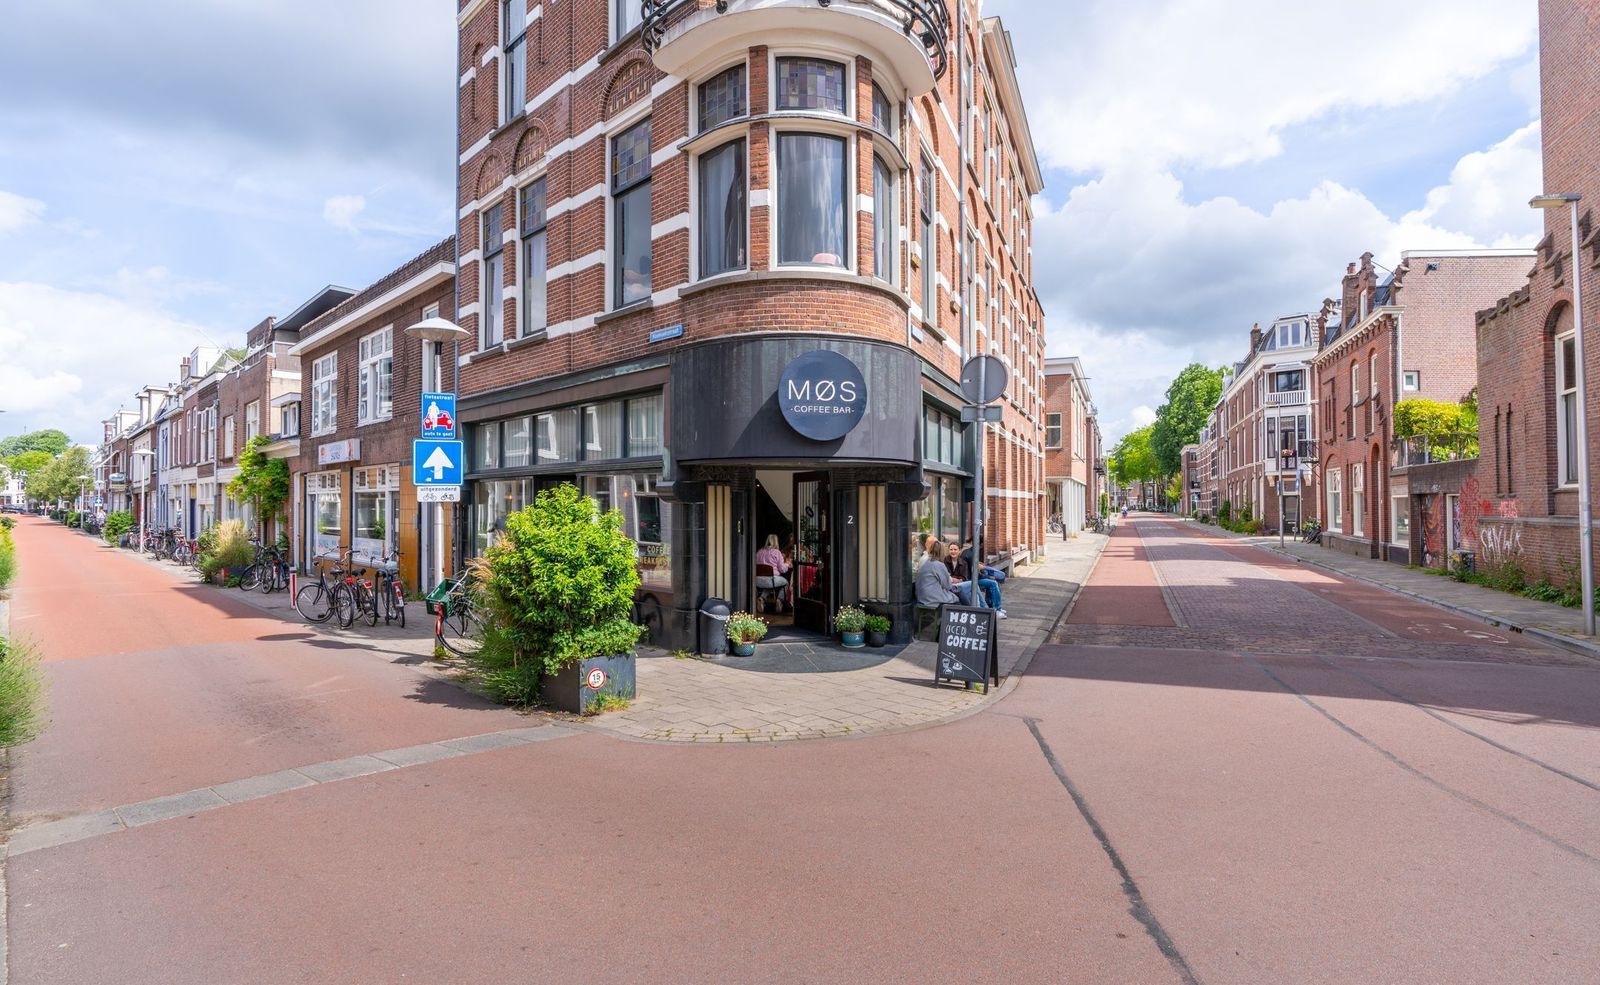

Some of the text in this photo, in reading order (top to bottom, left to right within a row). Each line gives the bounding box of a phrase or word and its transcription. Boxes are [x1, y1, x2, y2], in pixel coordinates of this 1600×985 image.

[788, 379, 856, 402] MØS
[847, 515, 854, 524] 2
[946, 635, 987, 651] COFFEE
[592, 672, 601, 680] 15
